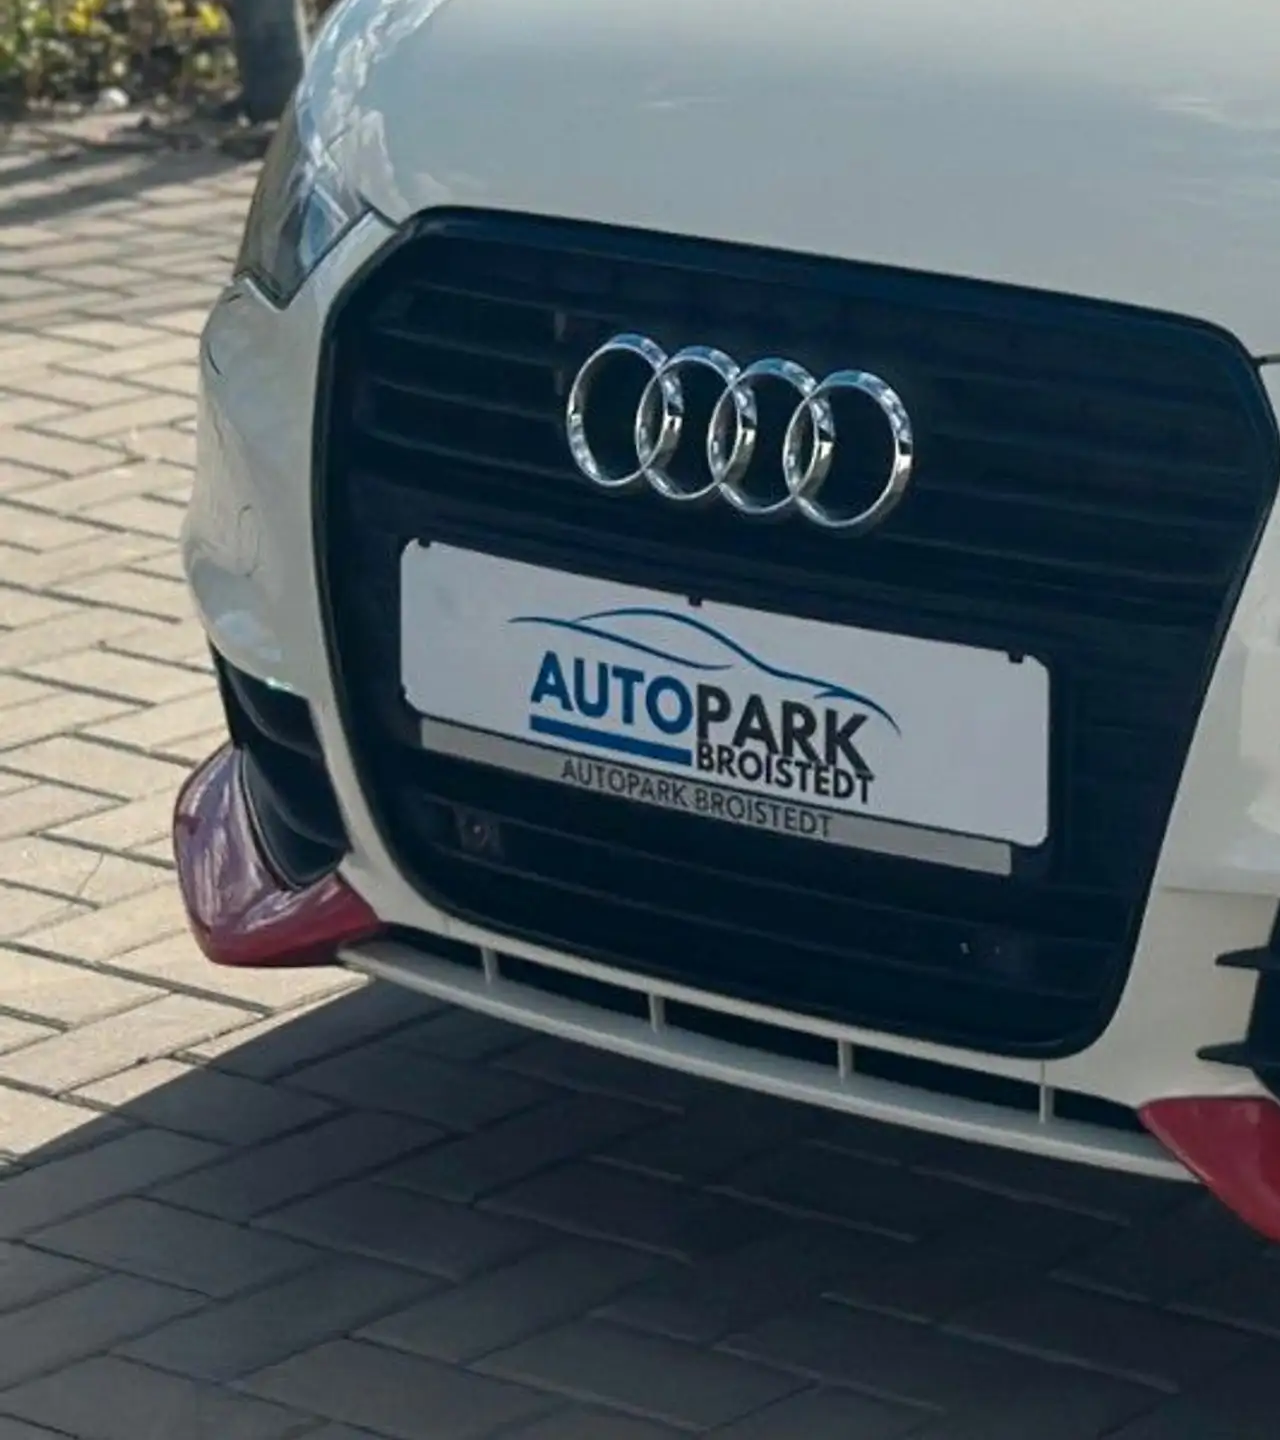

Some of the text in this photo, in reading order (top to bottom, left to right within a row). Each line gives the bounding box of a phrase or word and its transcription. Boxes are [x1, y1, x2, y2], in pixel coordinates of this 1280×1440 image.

[530, 650, 873, 773] AUTOPARK
[561, 757, 835, 839] AUTOPARK BROISTEDT
[696, 741, 875, 805] BROISTEDT
